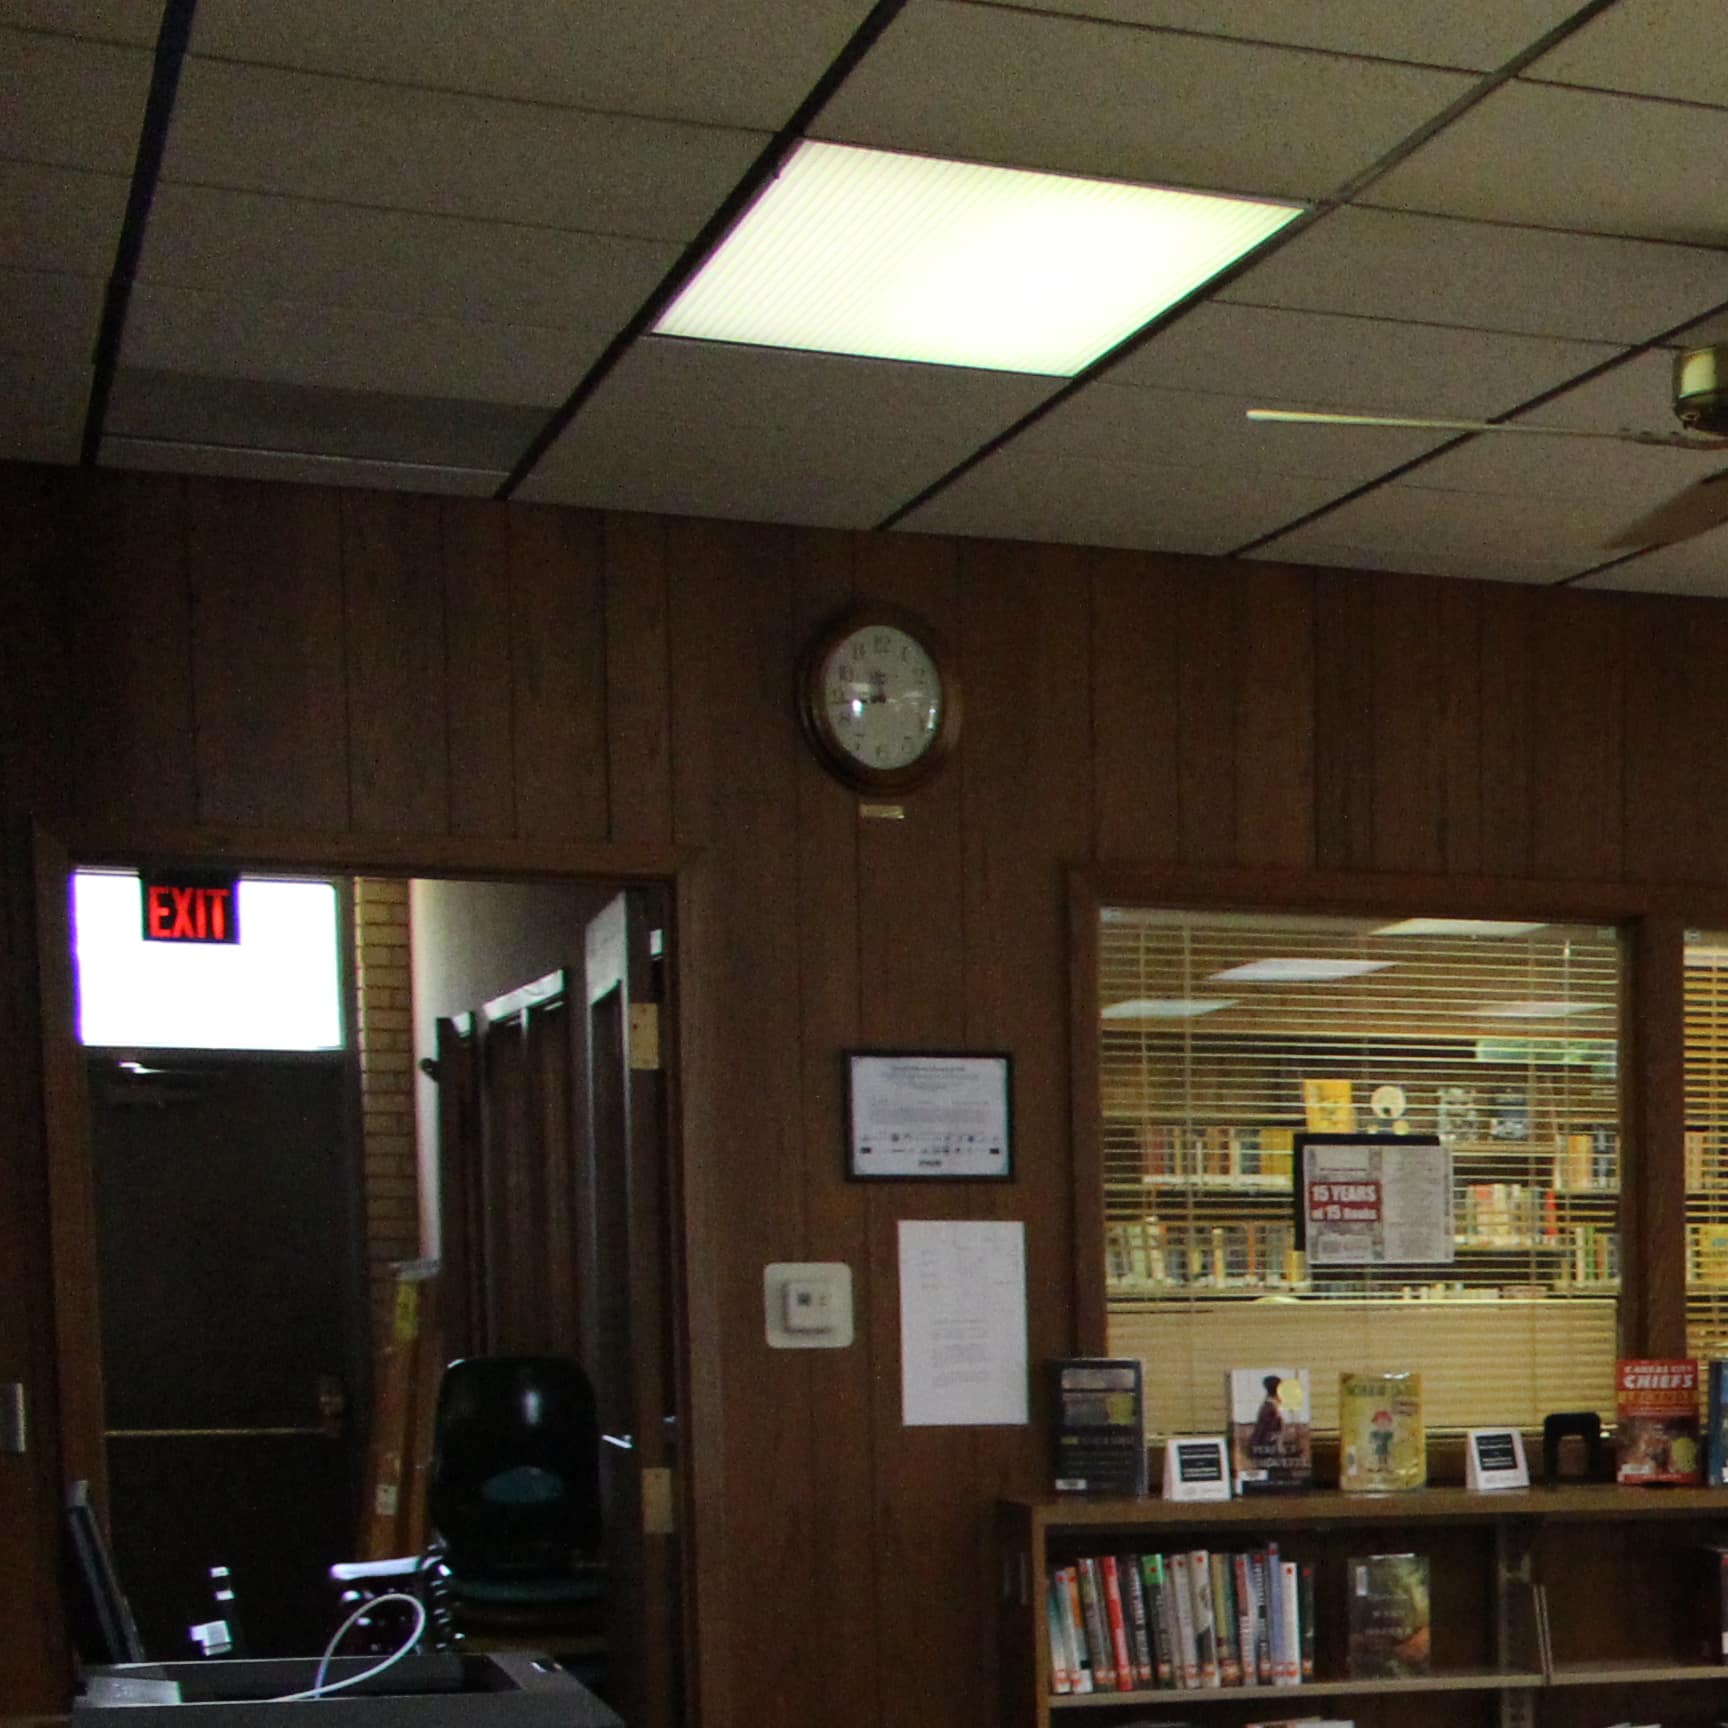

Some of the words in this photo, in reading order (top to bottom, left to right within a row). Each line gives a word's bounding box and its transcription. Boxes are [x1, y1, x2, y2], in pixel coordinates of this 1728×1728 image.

[148, 886, 228, 939] EXIT
[1312, 1185, 1328, 1202] 15
[1333, 1185, 1376, 1202] YEARS
[1327, 1205, 1340, 1220] 15
[1623, 1374, 1694, 1389] CHIEFS
